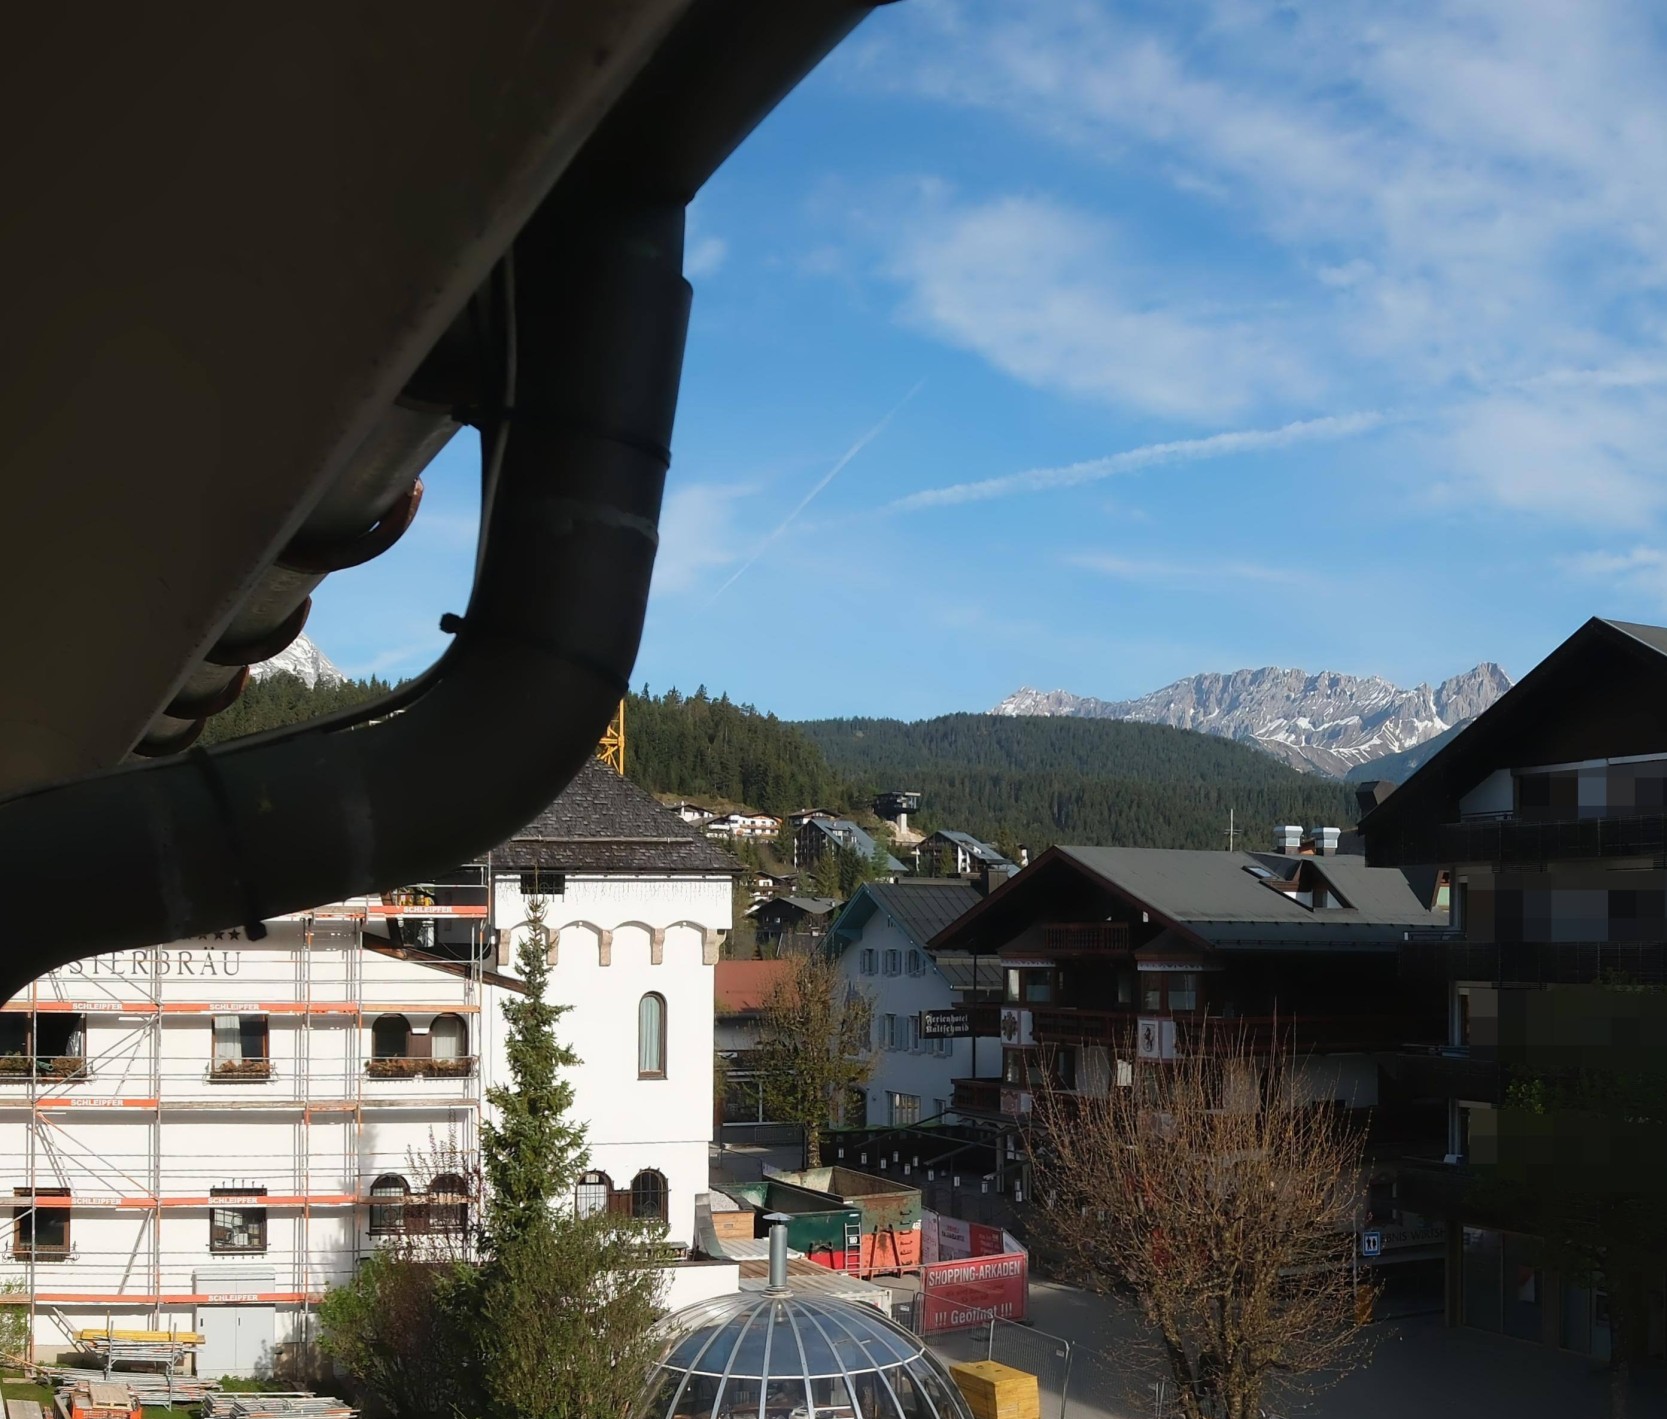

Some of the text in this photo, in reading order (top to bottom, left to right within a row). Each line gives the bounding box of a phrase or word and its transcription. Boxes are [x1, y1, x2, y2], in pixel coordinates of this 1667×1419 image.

[55, 946, 241, 976] STERBRÄU
[71, 1099, 123, 1107] SCHLEIPFER
[928, 1260, 1021, 1287] SHOPPING-ARKADEN
[951, 1305, 997, 1324] Geöffnet
